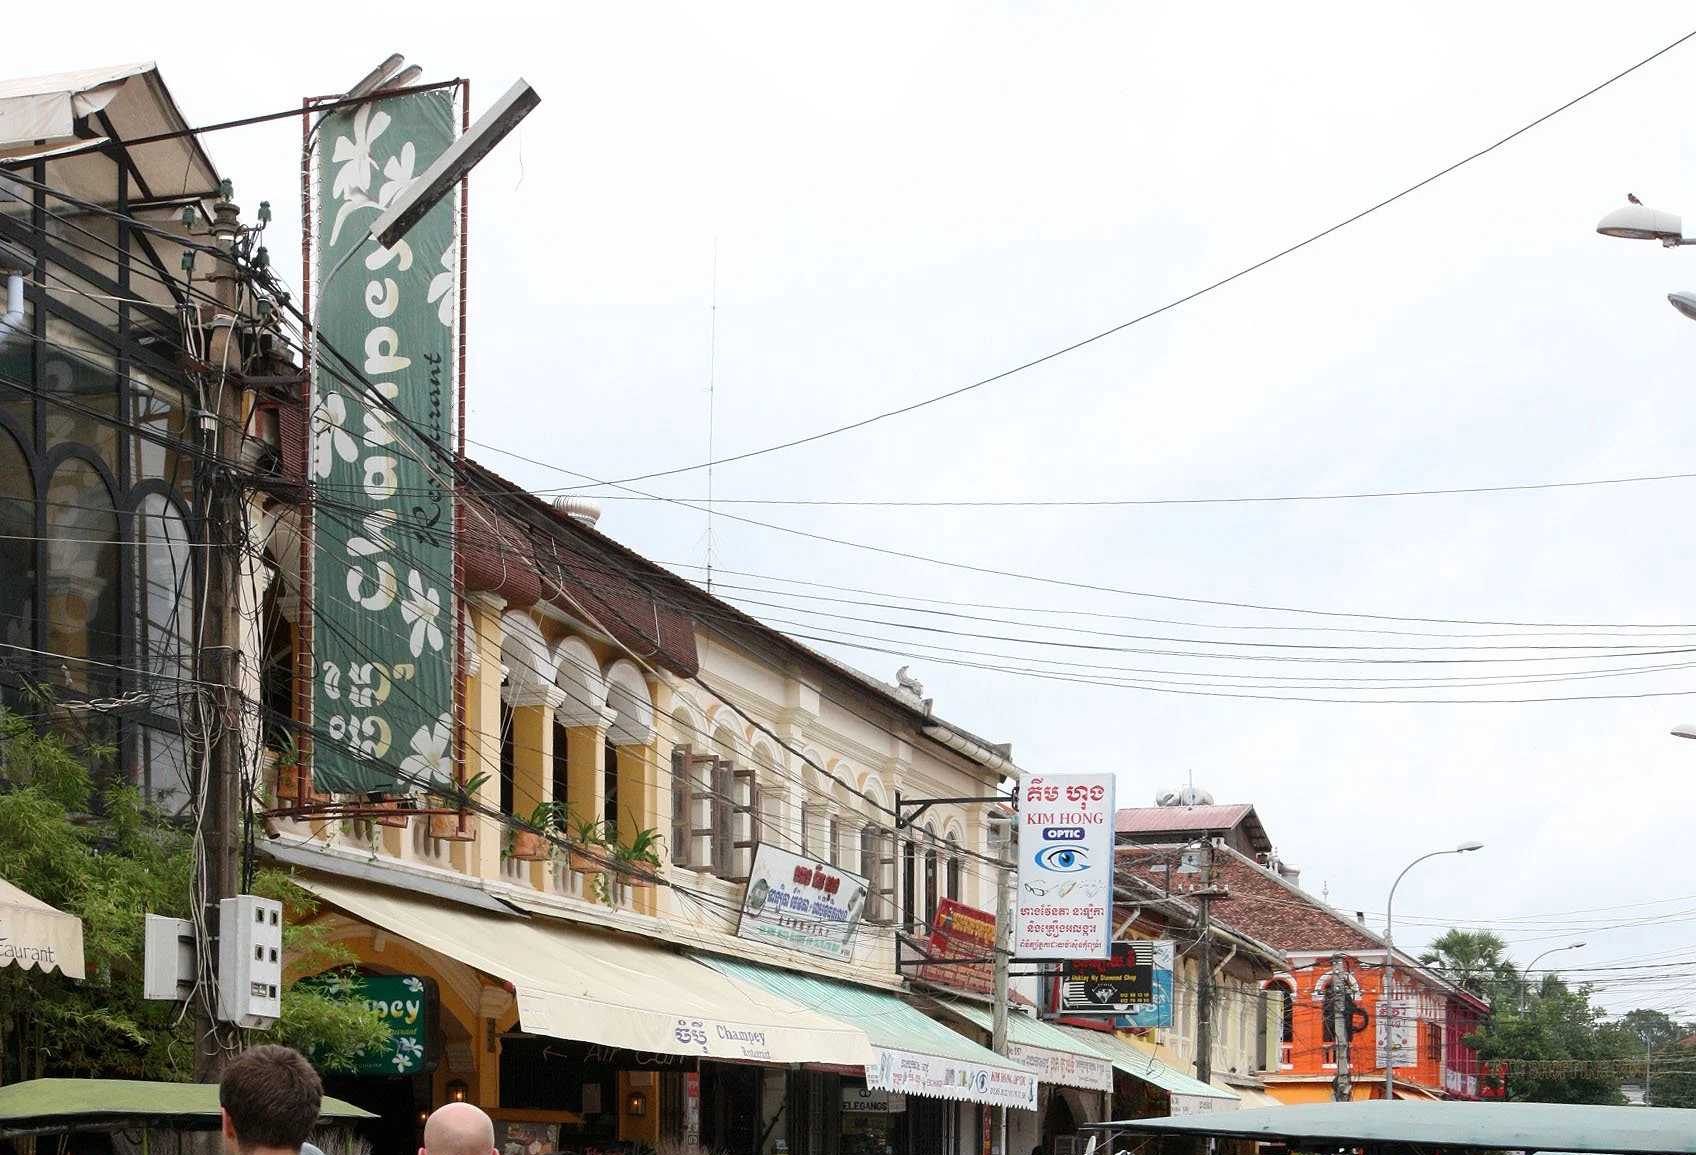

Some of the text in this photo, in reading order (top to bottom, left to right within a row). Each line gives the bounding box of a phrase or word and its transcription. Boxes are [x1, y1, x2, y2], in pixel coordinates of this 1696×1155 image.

[1027, 812, 1104, 825] KIM HONG
[1047, 829, 1081, 839] OPTIC
[1123, 973, 1137, 982] Shop
[716, 1025, 766, 1046] Champey
